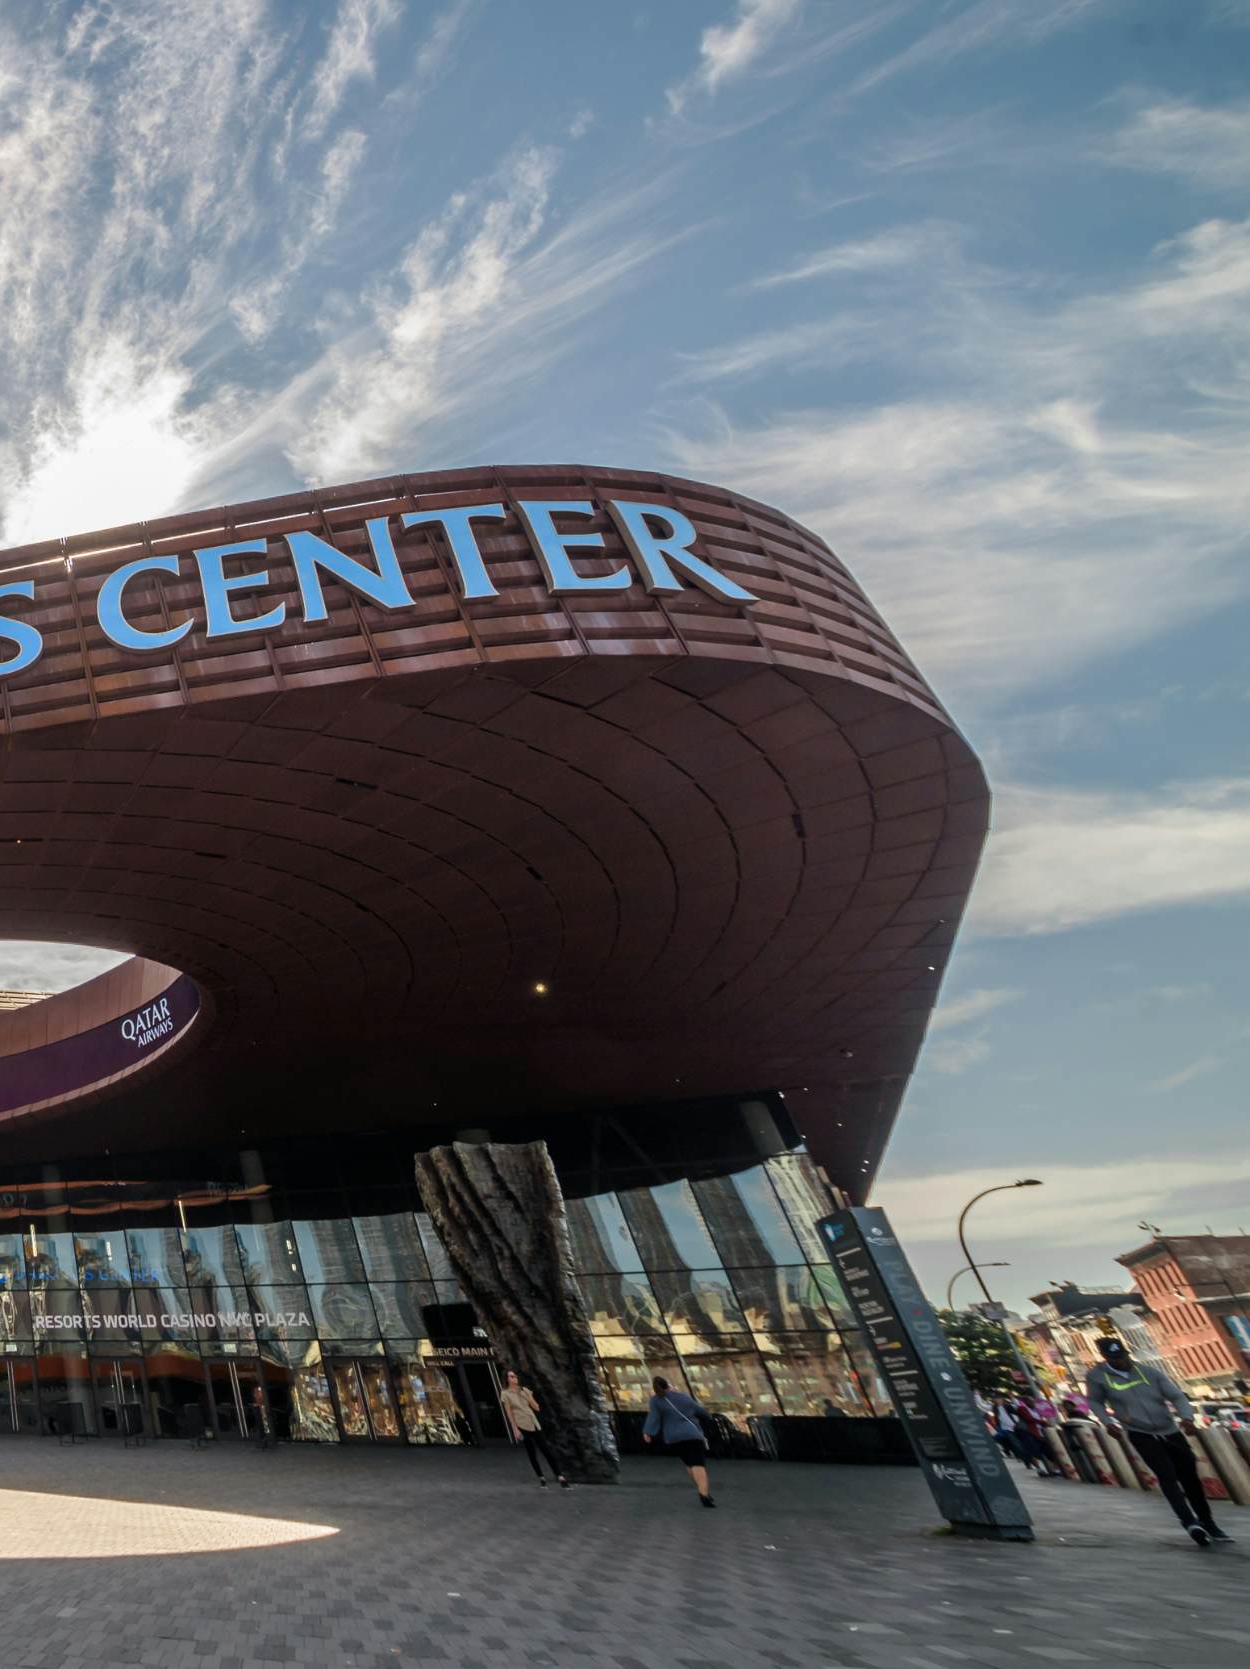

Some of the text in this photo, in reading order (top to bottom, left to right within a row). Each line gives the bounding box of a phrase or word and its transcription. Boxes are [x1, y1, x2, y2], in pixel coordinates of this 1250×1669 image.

[96, 499, 761, 650] CENTER
[121, 997, 171, 1041] QATAR
[137, 1017, 174, 1048] AIRWAYS
[34, 1311, 311, 1330] RESORTS WORLD CASINO NYC PLAZA
[461, 1347, 488, 1356] MAIN
[911, 1320, 951, 1369] DINE
[943, 1387, 1000, 1478] UNWIND
